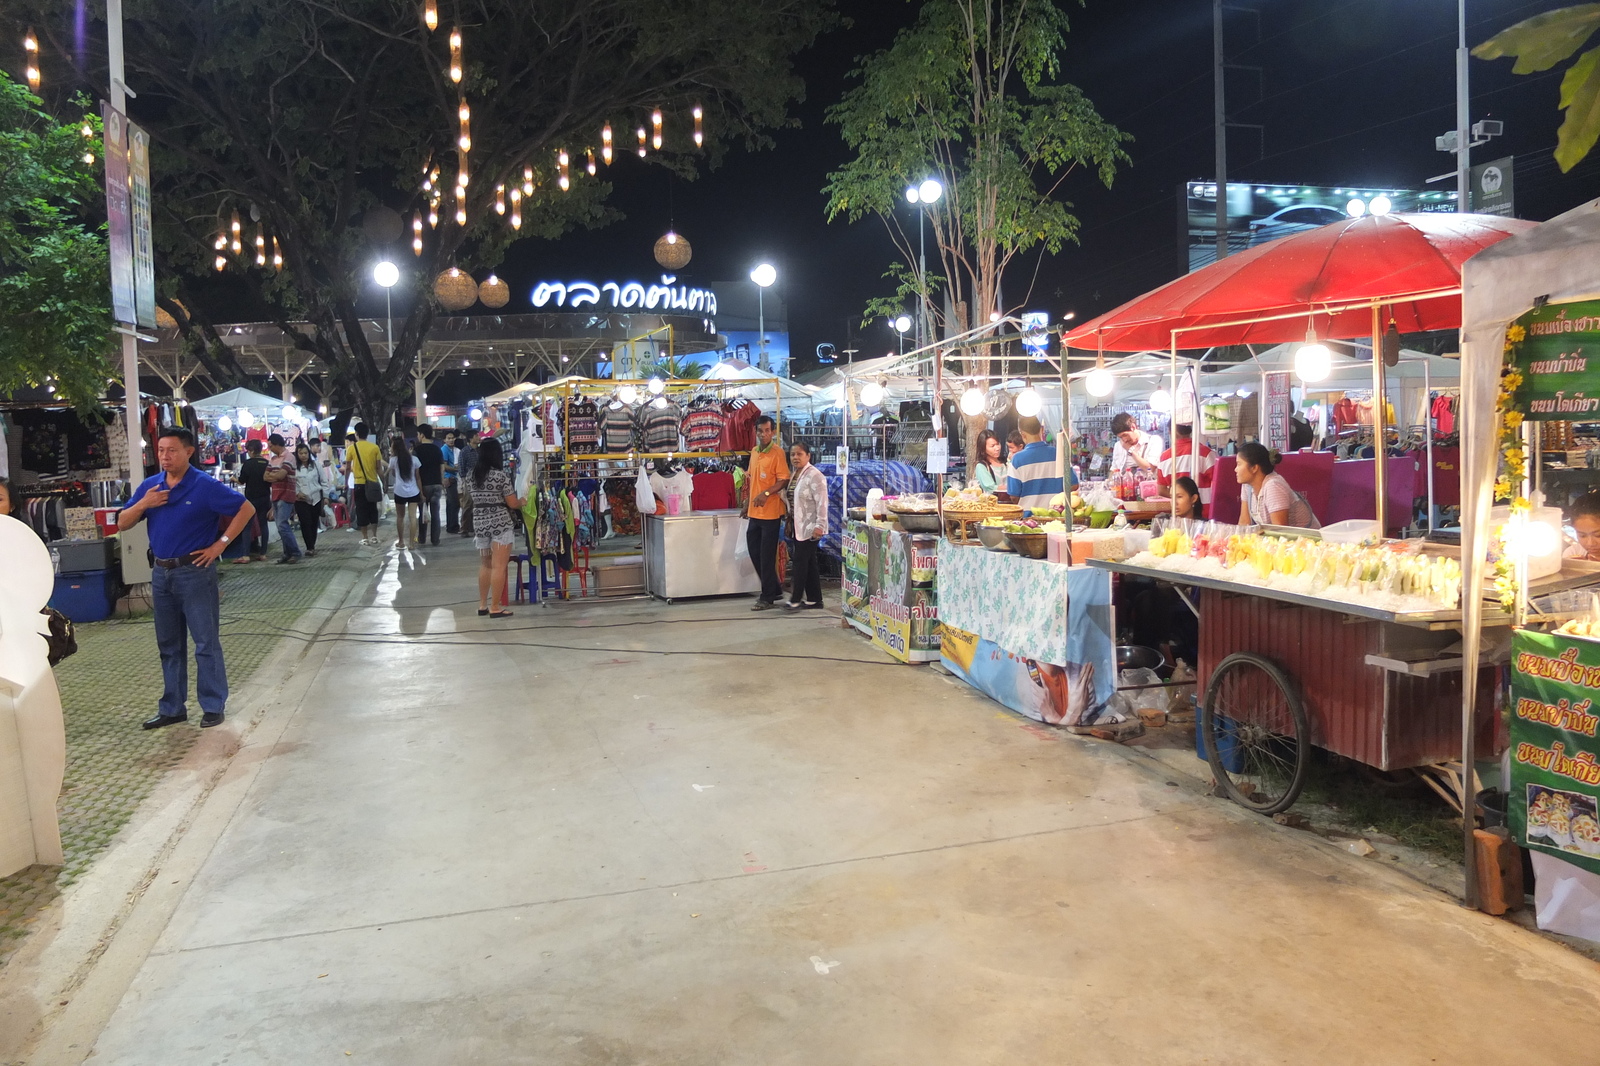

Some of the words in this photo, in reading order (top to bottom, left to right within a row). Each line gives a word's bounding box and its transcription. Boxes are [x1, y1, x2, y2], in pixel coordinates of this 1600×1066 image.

[531, 274, 717, 316] ตลาดต้นตาล
[1517, 698, 1599, 737] ขนมบ้าบิ่น
